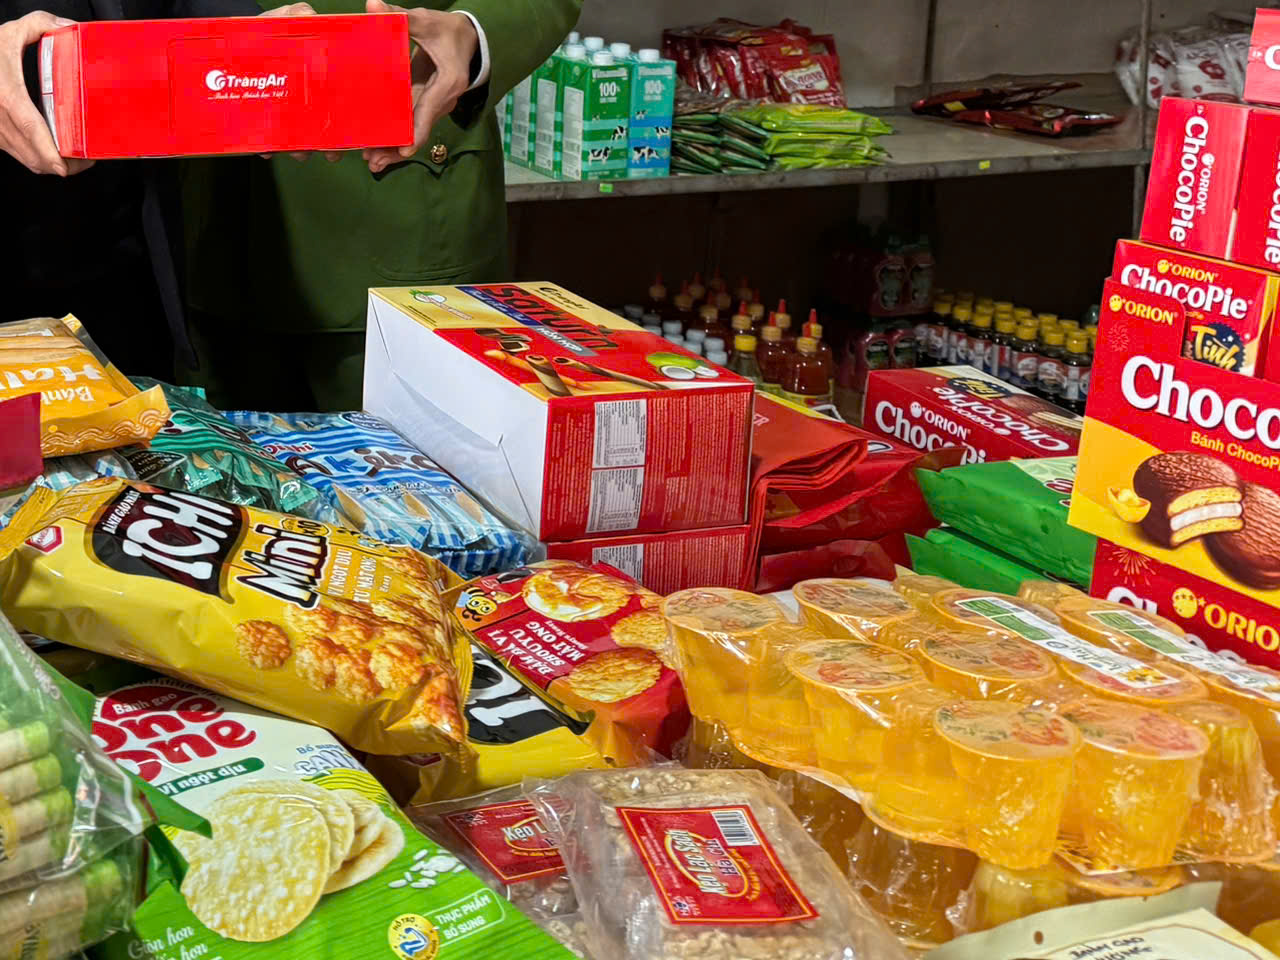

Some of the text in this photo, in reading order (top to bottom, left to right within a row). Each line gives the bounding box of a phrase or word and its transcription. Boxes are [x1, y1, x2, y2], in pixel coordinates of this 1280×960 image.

[1169, 116, 1210, 243] ChocoPie
[1196, 167, 1213, 213] ORION
[1120, 263, 1248, 320] ChocoPie
[1171, 263, 1215, 284] ORION
[1124, 300, 1174, 326] ORION
[1120, 355, 1280, 451] Choco
[924, 409, 969, 440] ORION
[1191, 431, 1280, 473] Bánh ChocoPi
[236, 524, 328, 610] Mini
[1204, 603, 1280, 652] ORIO
[113, 698, 149, 716] Bánh
[178, 763, 248, 790] ngọt dịu
[458, 915, 485, 935] SUNG
